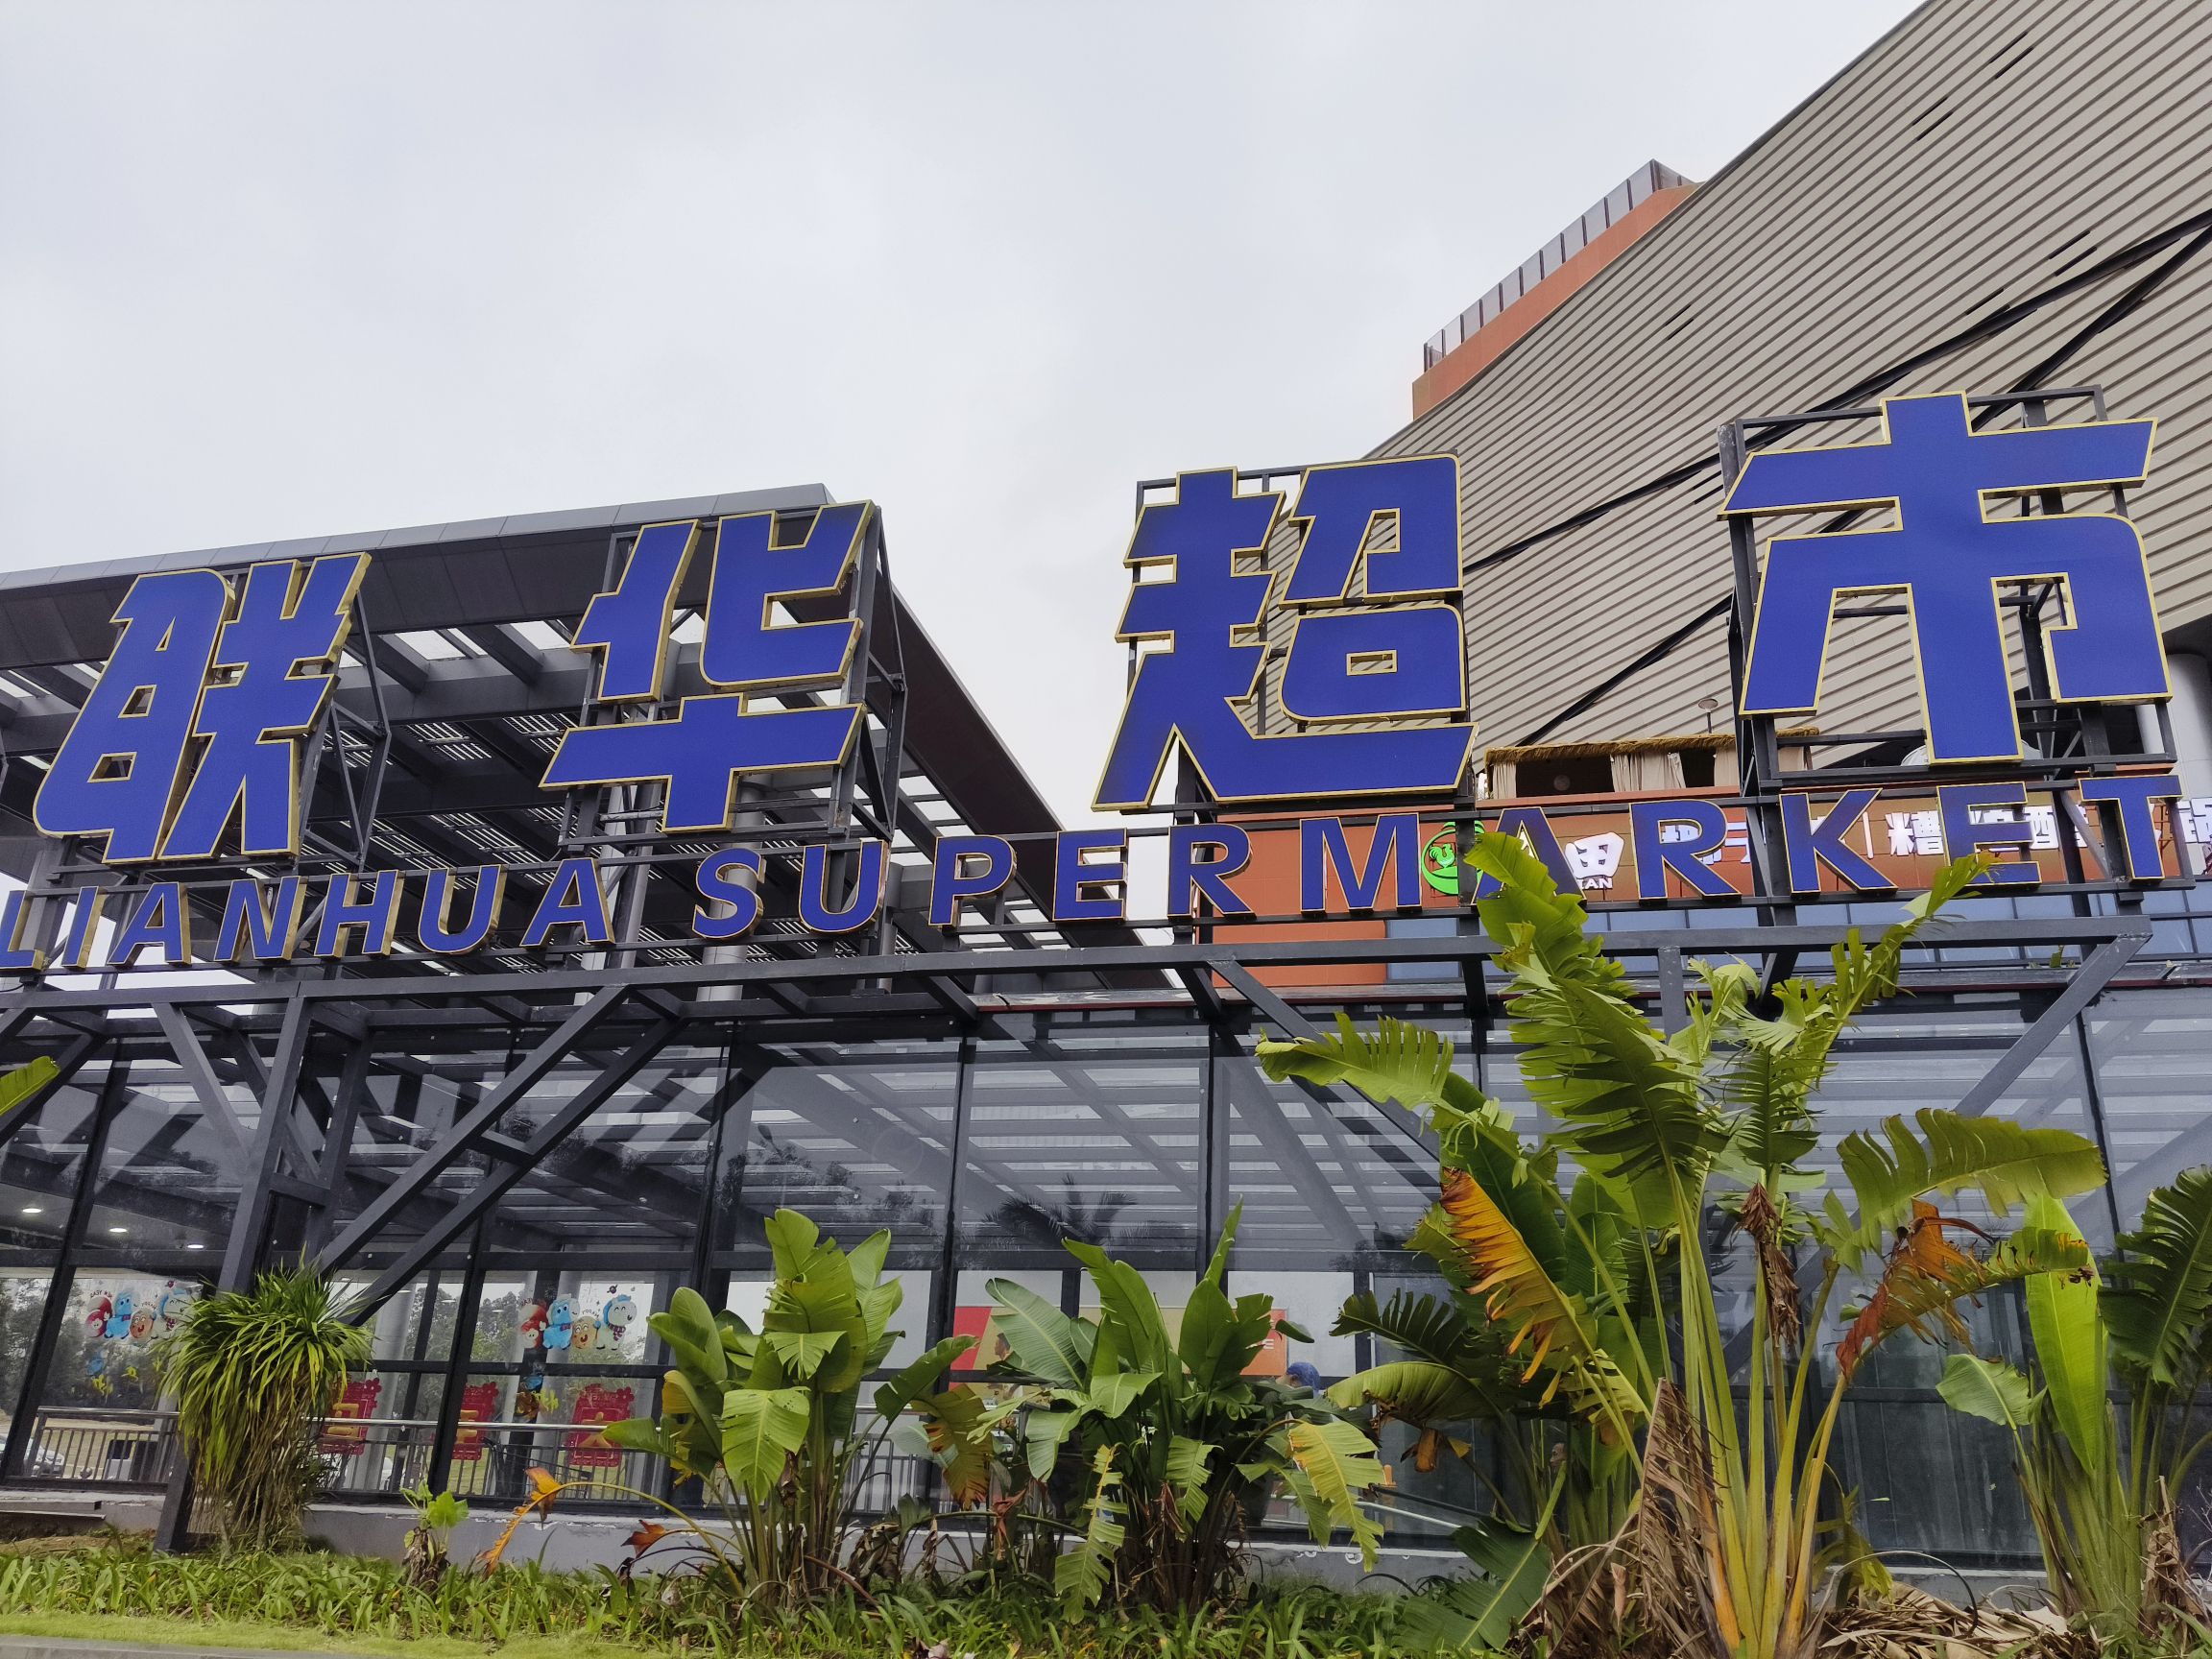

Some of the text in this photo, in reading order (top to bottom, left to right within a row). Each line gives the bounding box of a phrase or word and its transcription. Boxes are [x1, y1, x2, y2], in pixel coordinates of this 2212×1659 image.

[33, 390, 2173, 864] 联华超市
[0, 774, 2183, 970] LIANHUA SUPERMARKET
